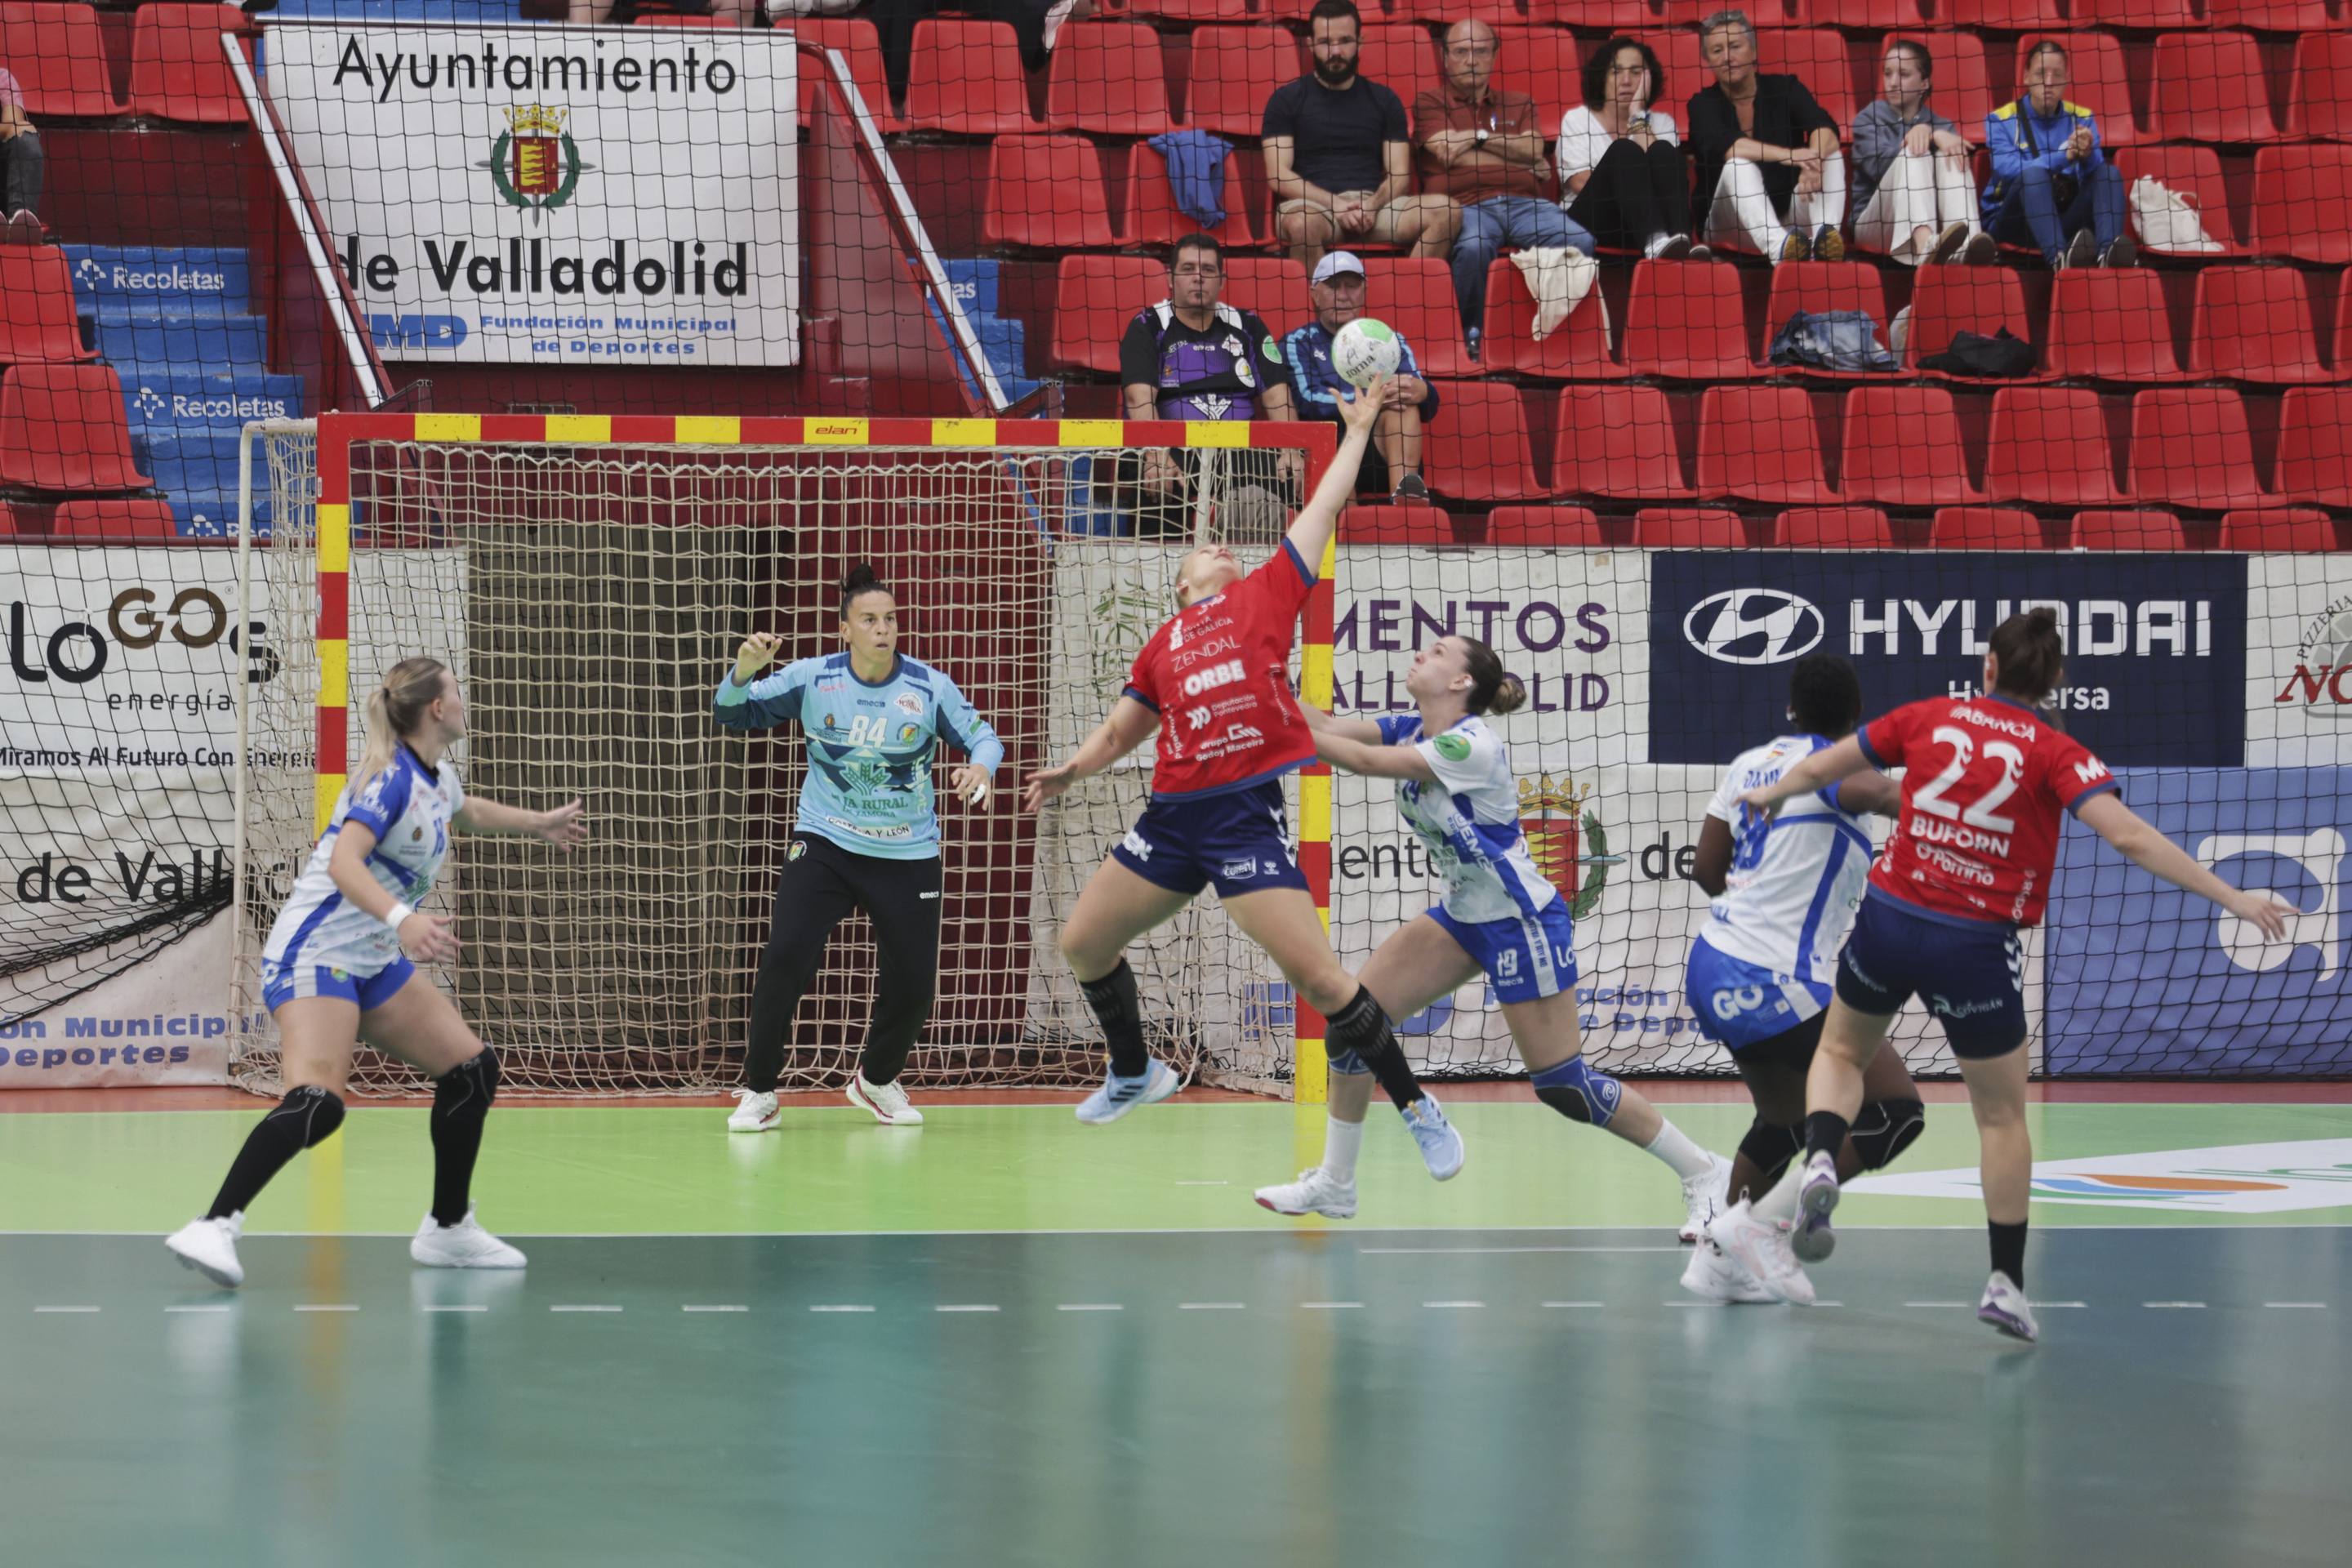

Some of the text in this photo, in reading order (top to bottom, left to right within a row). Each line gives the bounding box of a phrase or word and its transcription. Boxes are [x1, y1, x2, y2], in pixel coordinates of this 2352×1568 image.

[333, 35, 737, 103] Ayuntamiento
[113, 265, 225, 291] Recoletas
[338, 235, 747, 296] de Valladolid
[363, 314, 467, 350] MD
[480, 314, 737, 334] Fundación Municipal
[532, 339, 696, 356] de Deportes
[172, 393, 286, 418] Recoletas
[815, 425, 858, 435] elan
[1197, 617, 1234, 637] GALICIA
[1171, 635, 1242, 673] ZENDAL
[1184, 659, 1247, 697] ORBE
[108, 688, 231, 716] energía
[847, 714, 889, 750] 84
[1950, 704, 2036, 743] ABANCA
[87, 746, 109, 767] Al
[117, 746, 188, 767] Futuro
[195, 747, 234, 767] Con
[1911, 725, 2025, 835] 22
[862, 796, 909, 810] RURAL
[1909, 813, 2010, 858] BUFORN
[16, 851, 91, 903] de
[0, 1045, 190, 1069] eportes
